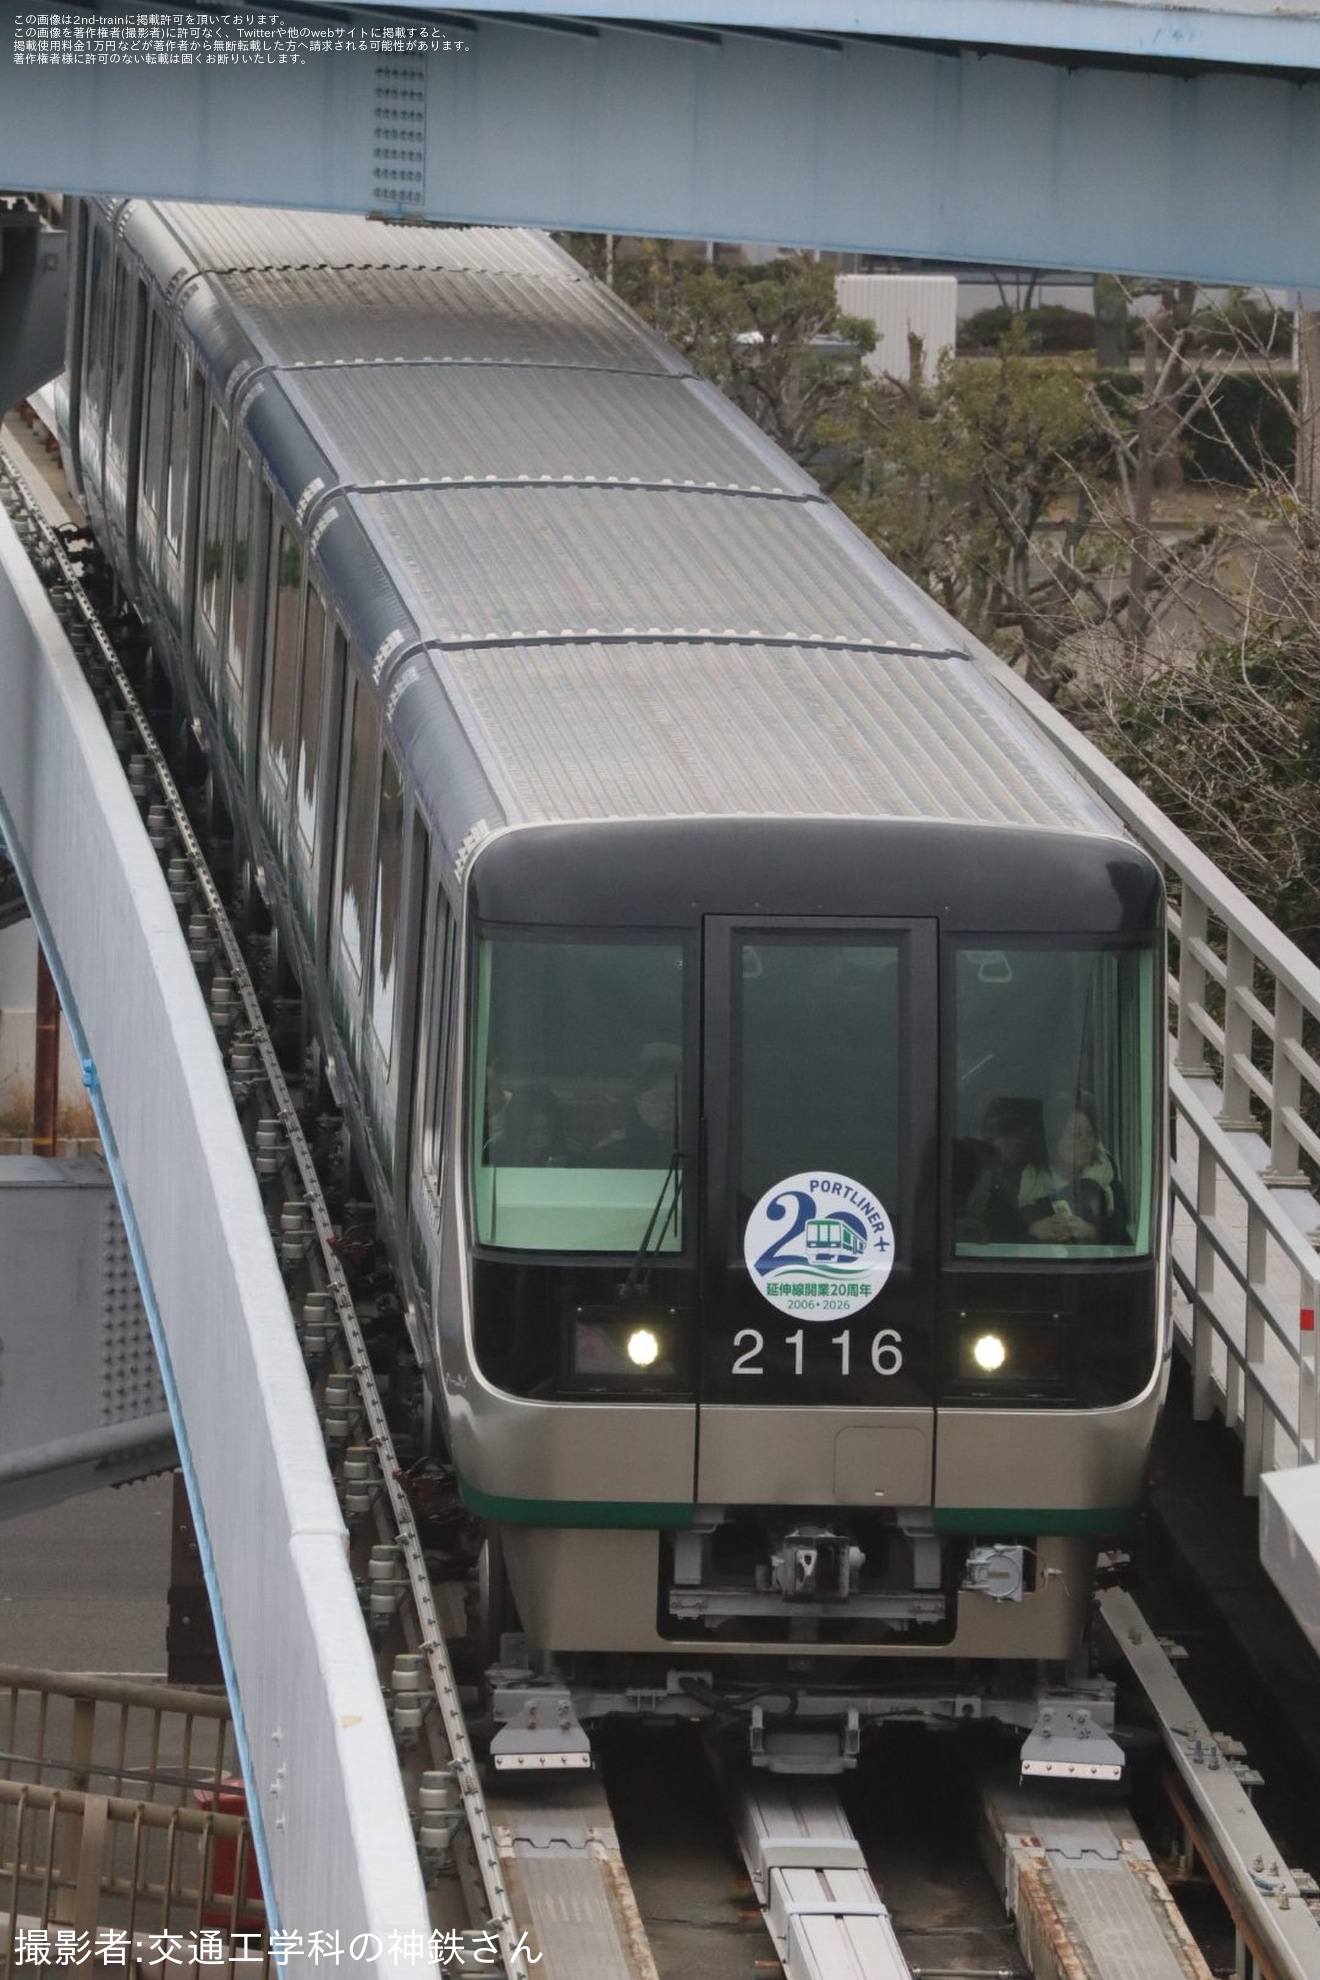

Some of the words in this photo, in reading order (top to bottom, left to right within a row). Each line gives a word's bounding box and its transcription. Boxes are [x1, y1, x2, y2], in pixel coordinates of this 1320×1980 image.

[809, 1179, 886, 1234] PORTLINER
[766, 1282, 872, 1298] 延伸線開業20周年
[731, 1328, 903, 1376] 2116
